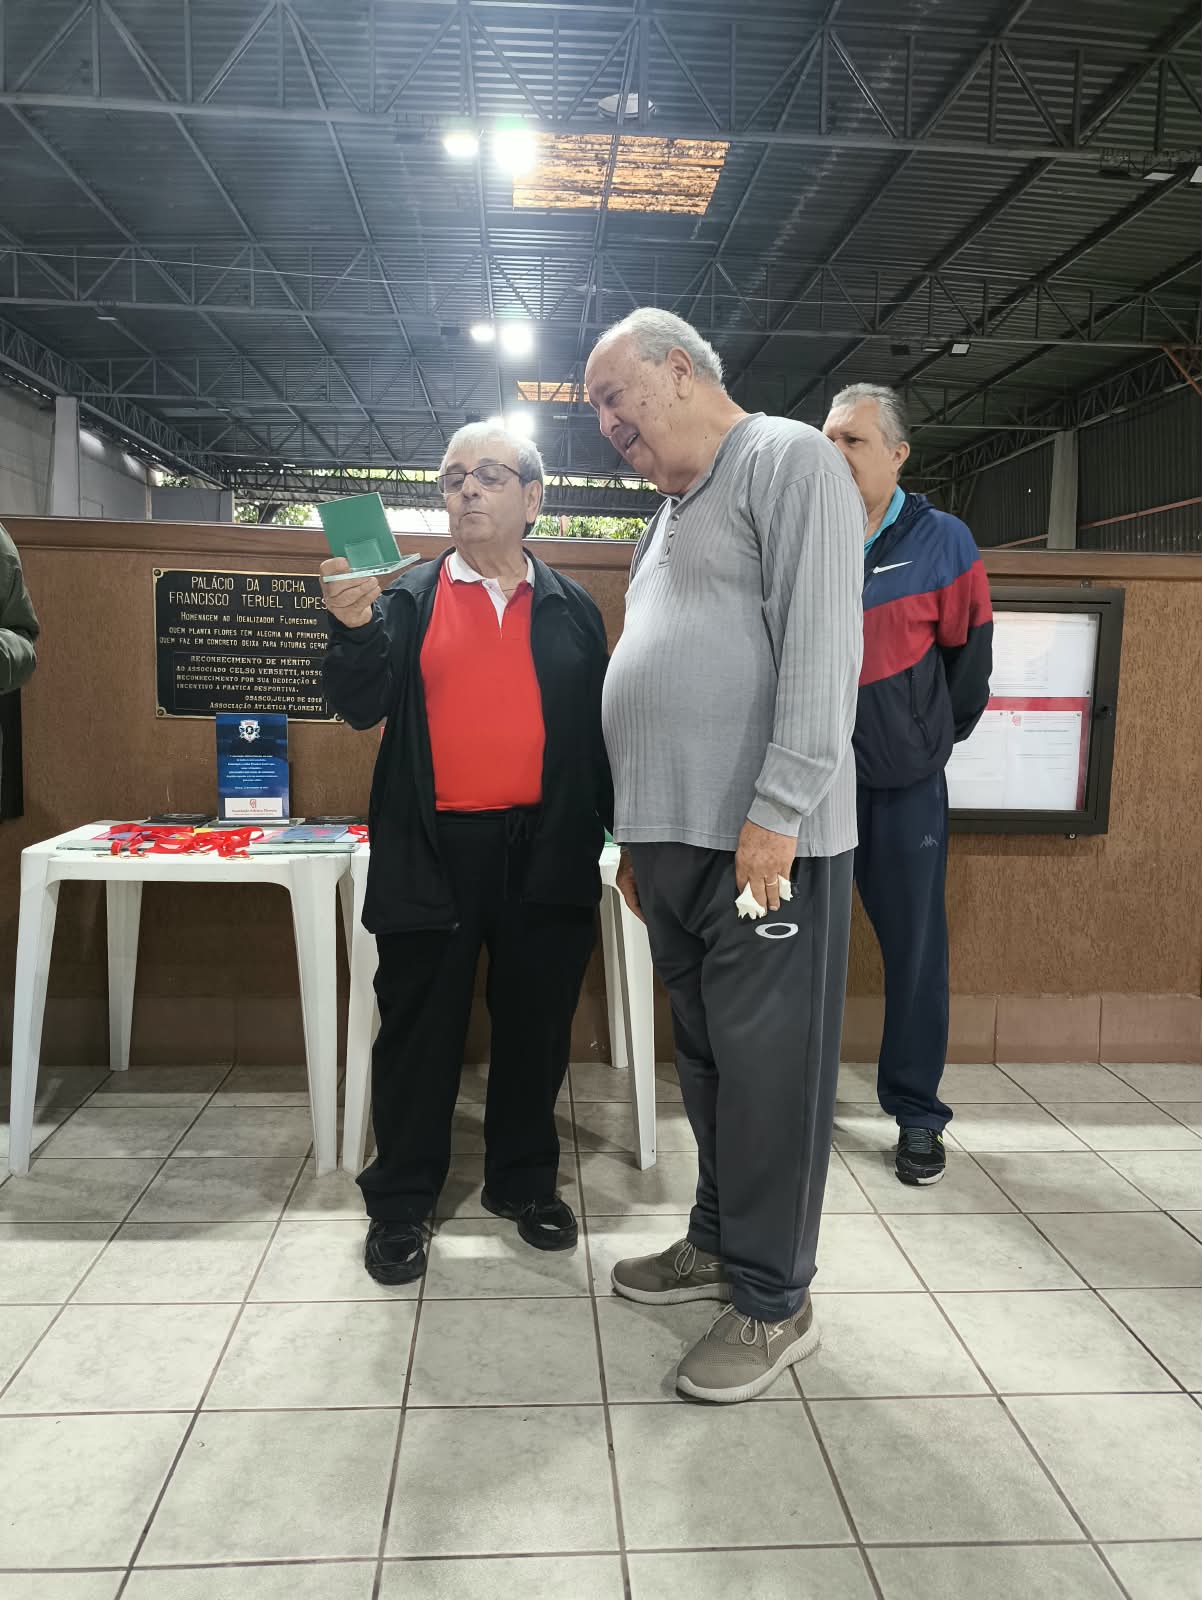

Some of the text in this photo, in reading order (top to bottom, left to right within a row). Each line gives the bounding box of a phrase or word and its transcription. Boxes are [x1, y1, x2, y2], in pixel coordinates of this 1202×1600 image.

[191, 575, 306, 593] PALÁCIO DA BOCHA
[169, 591, 328, 610] FRANCISCO TERUEL LOPES
[169, 626, 186, 634] QUEM
[188, 627, 211, 635] PLANTA
[214, 628, 237, 636] FLORES
[240, 629, 252, 637] TEM
[256, 630, 281, 638] ALEGRIA
[296, 632, 328, 640] PRIMAVERA
[160, 636, 176, 644] QUEM
[180, 637, 191, 645] FAZ
[206, 638, 238, 646] CONCRETO
[242, 639, 259, 647] DEIXA
[262, 640, 276, 648] PARA
[280, 640, 306, 649] FUTURAS
[190, 655, 262, 664] RECONHECIMENTO
[280, 657, 311, 666] MÉRITO
[188, 666, 226, 674] ASSOCIADO
